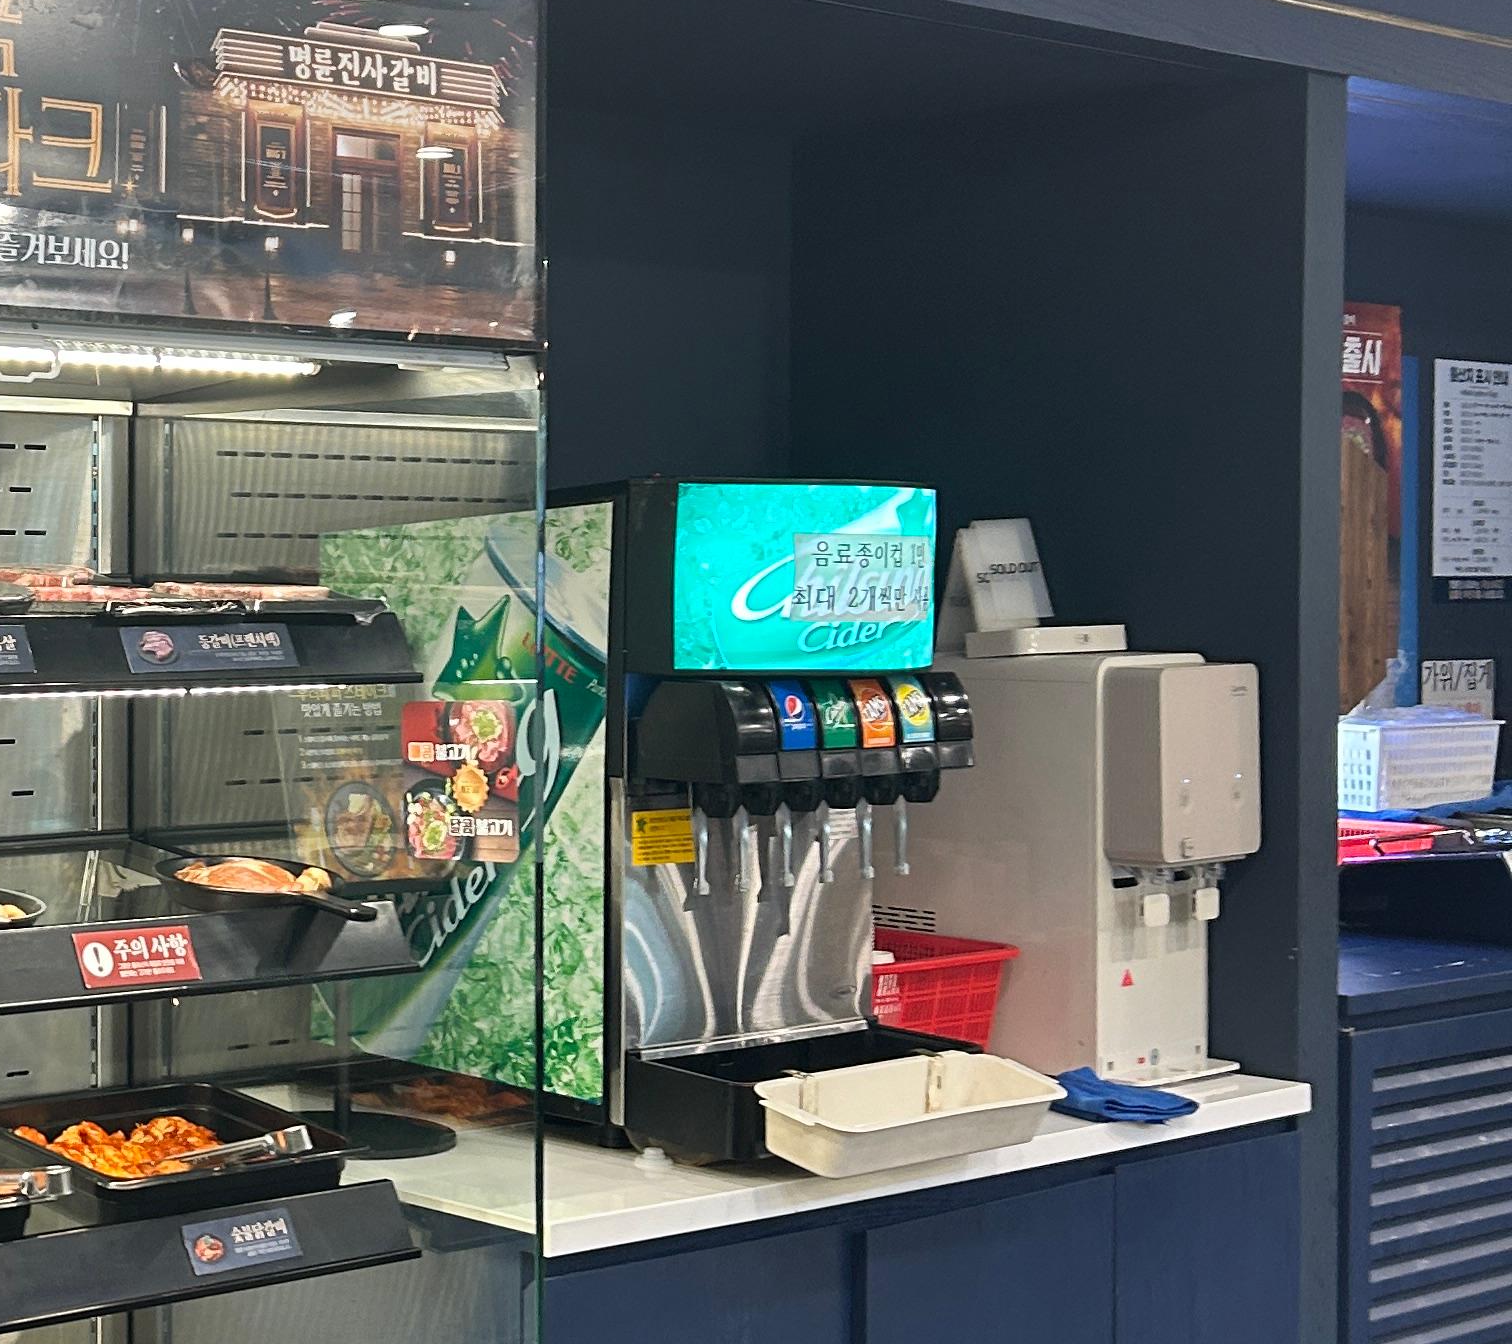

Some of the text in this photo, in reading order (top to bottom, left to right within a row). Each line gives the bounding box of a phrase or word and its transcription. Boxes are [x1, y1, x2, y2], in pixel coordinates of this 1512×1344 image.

[288, 44, 438, 96] 명륜진사갈비
[1342, 336, 1382, 376] 출시
[812, 541, 903, 568] 음료종이컵
[990, 563, 1016, 575] SOLD
[792, 585, 836, 611] 최대
[849, 586, 905, 611] 2개씩만
[798, 619, 896, 653] Cider
[476, 818, 512, 836] 불고기
[113, 933, 189, 961] 주의 사항
